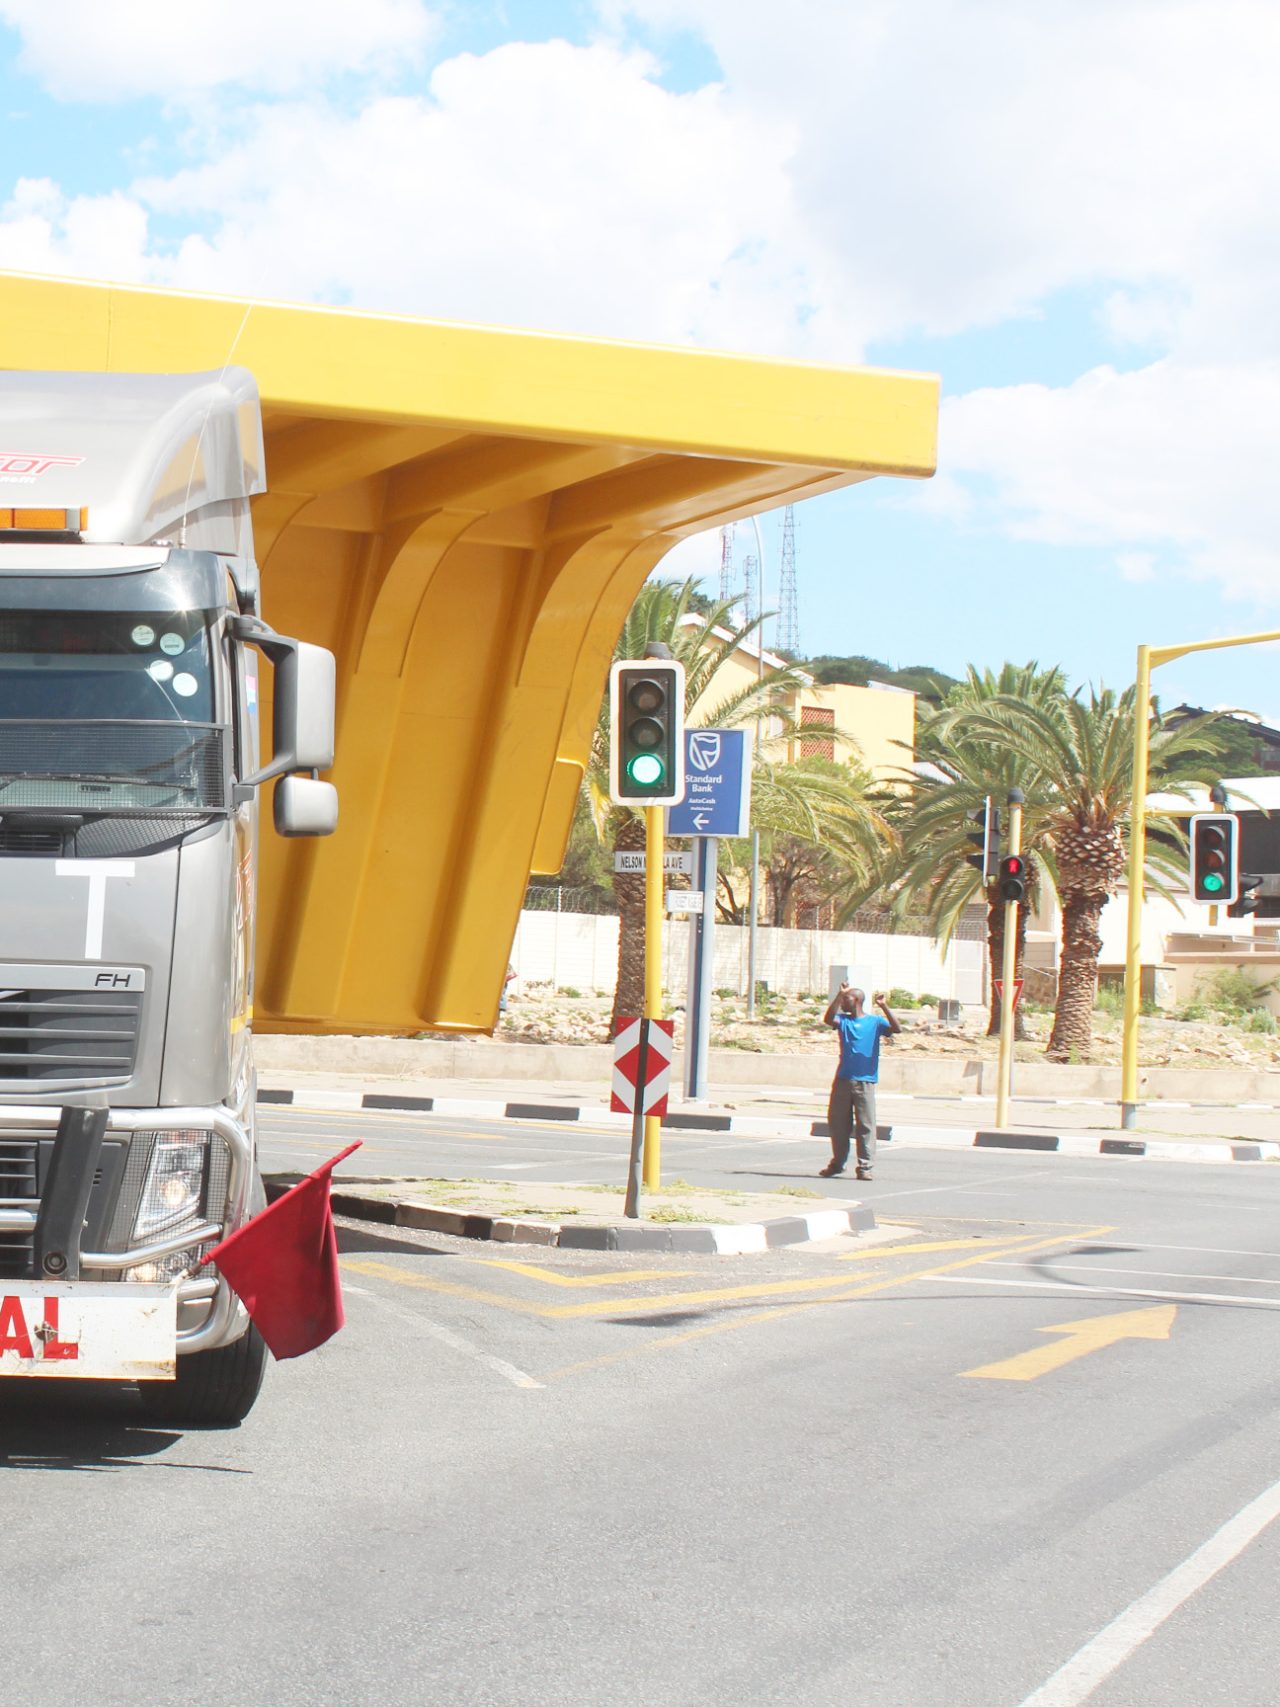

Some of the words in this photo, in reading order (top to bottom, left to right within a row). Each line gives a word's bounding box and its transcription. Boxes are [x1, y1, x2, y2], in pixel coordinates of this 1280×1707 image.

[685, 774, 722, 784] Standard
[692, 783, 713, 793] Bank
[621, 856, 642, 869] NELSON
[671, 857, 683, 869] AVE
[55, 860, 135, 959] T
[94, 973, 131, 988] FH
